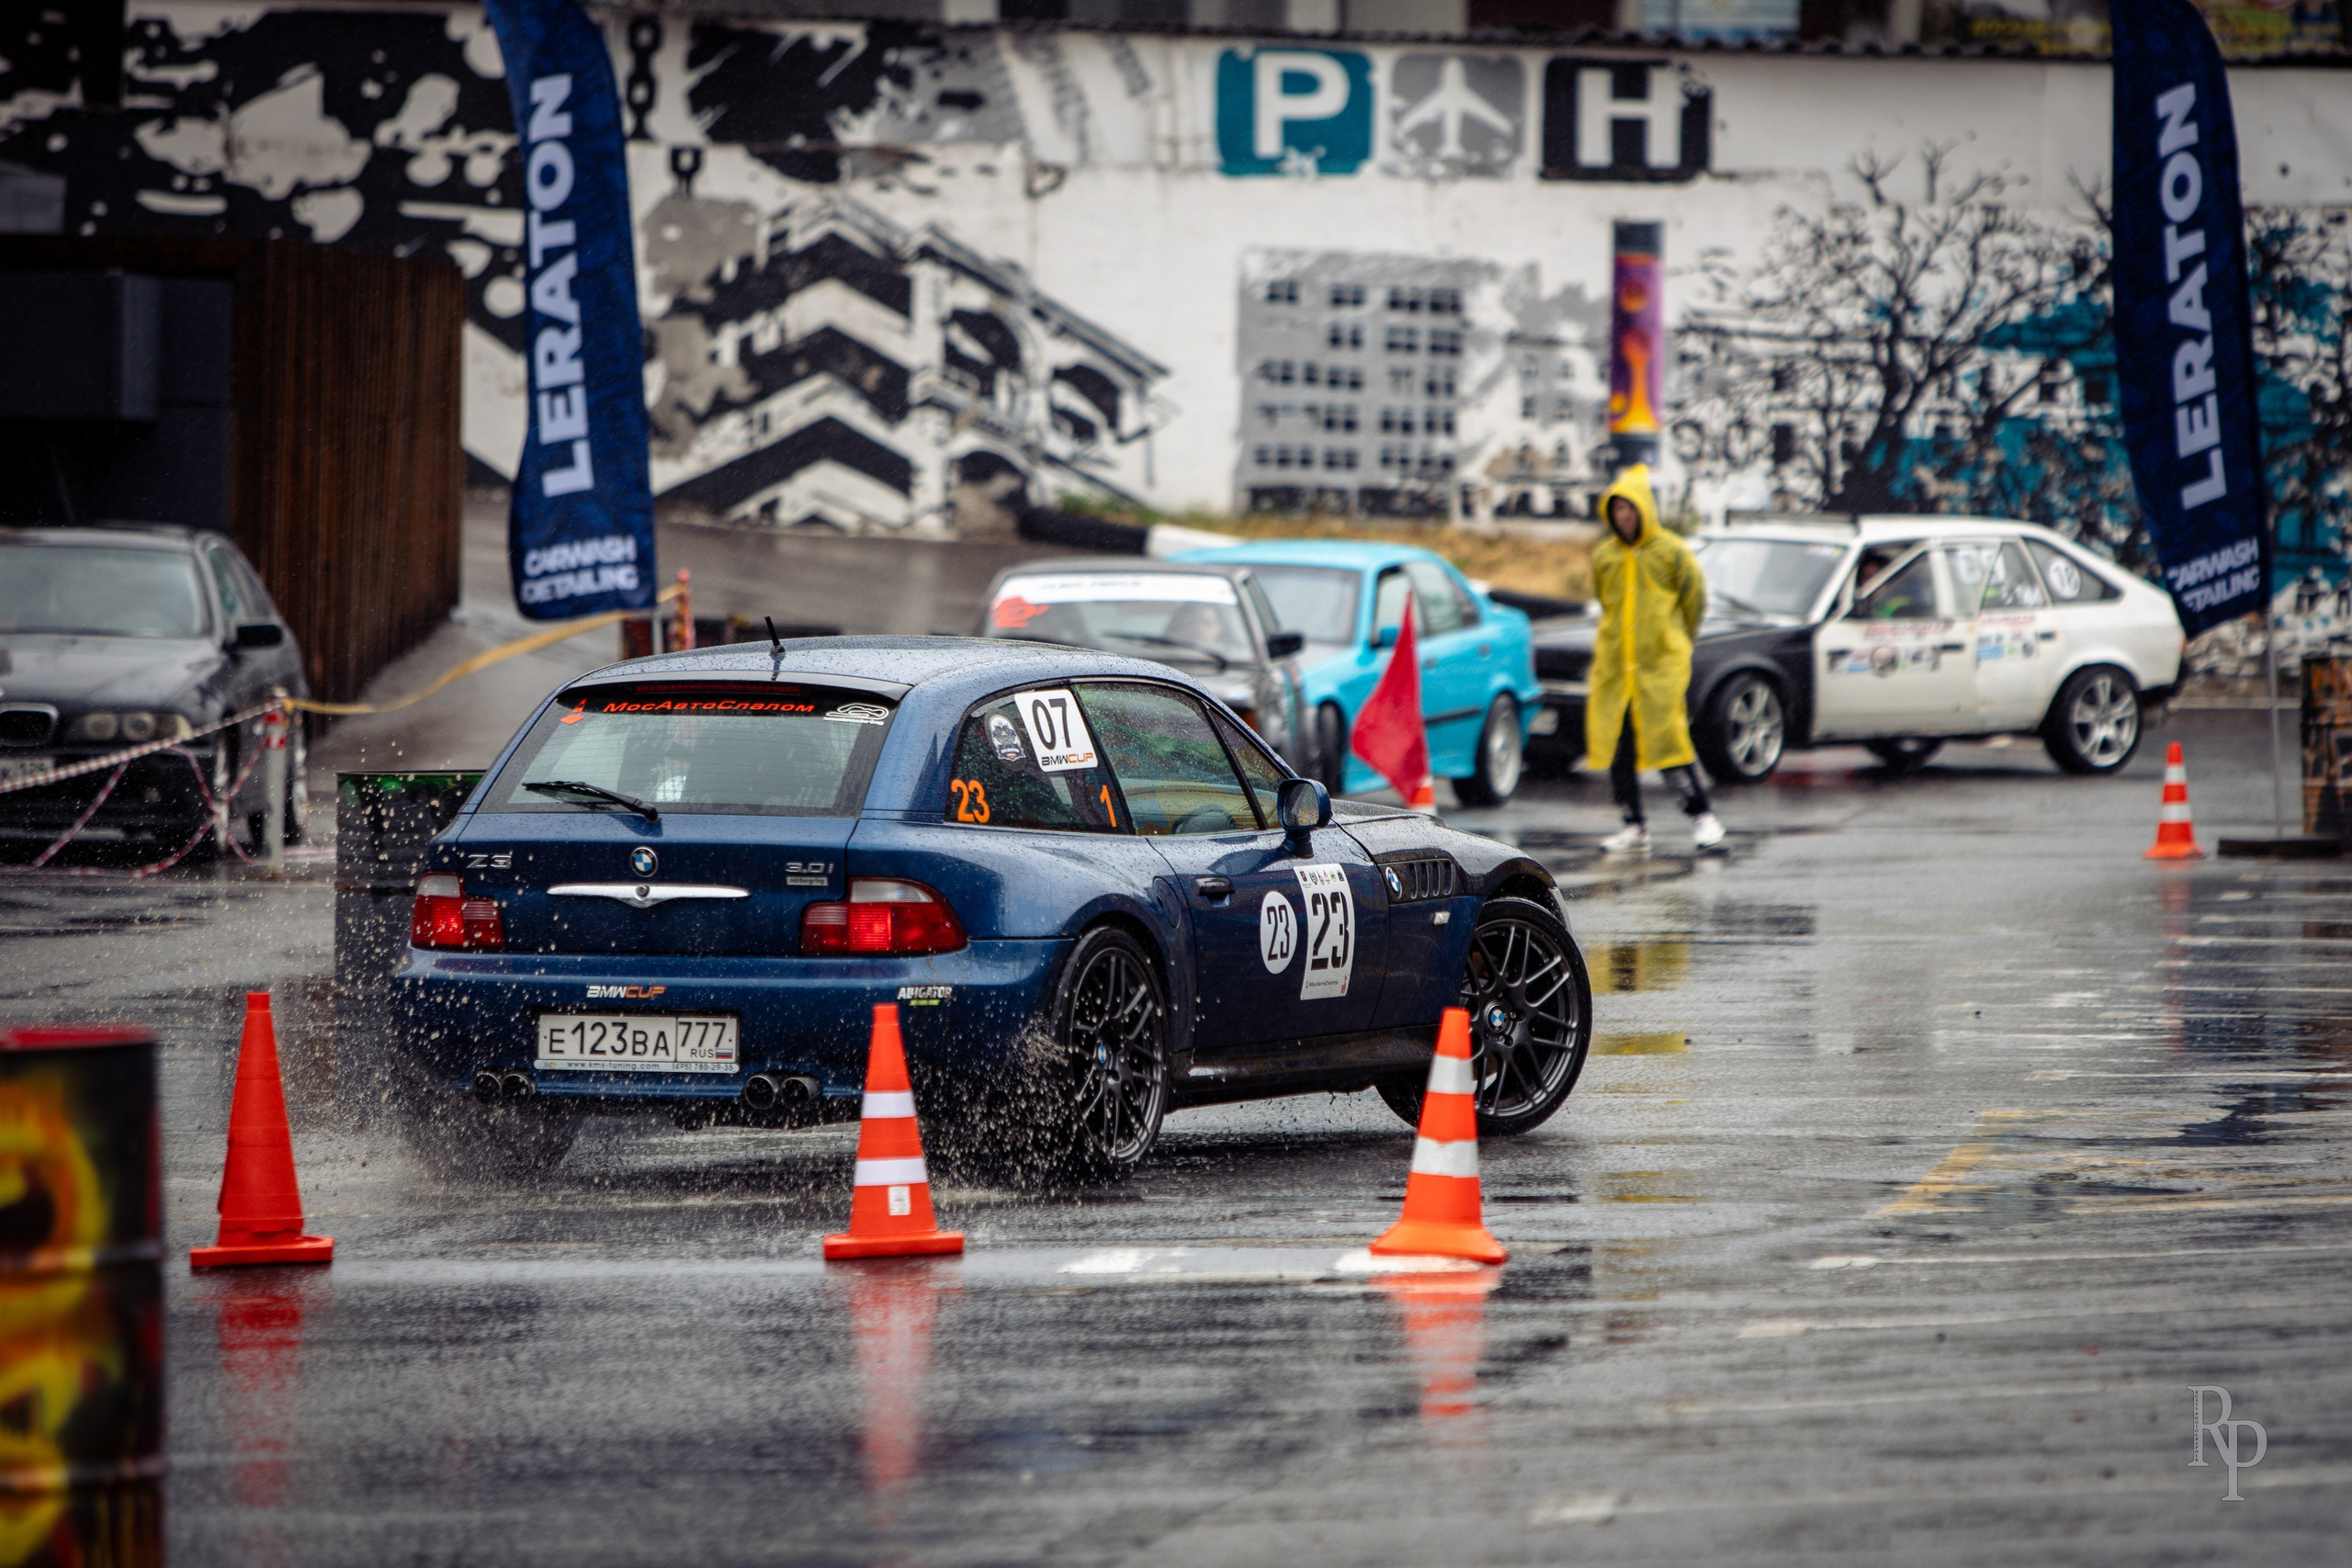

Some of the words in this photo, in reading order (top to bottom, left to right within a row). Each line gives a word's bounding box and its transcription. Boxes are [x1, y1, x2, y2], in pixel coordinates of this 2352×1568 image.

[1254, 51, 1351, 159] P
[1576, 67, 1684, 170] H
[526, 73, 594, 497] LERATON
[2155, 82, 2227, 511] LERATON
[524, 535, 638, 578] CARWASH
[603, 699, 815, 713] МосАвтоСлалом
[1032, 698, 1072, 750] 07
[1041, 752, 1094, 767] BMWCUP
[951, 779, 990, 824] 23
[1099, 784, 1117, 828] 1
[466, 853, 512, 870] Z3
[786, 862, 834, 874] 3.0i
[1266, 904, 1291, 962] 23
[1311, 891, 1351, 971] 23
[586, 985, 666, 998] BMWCUP
[678, 1021, 728, 1048] 777
[690, 1048, 714, 1059] RUS
[566, 1060, 661, 1071] www.kms-tuning.com
